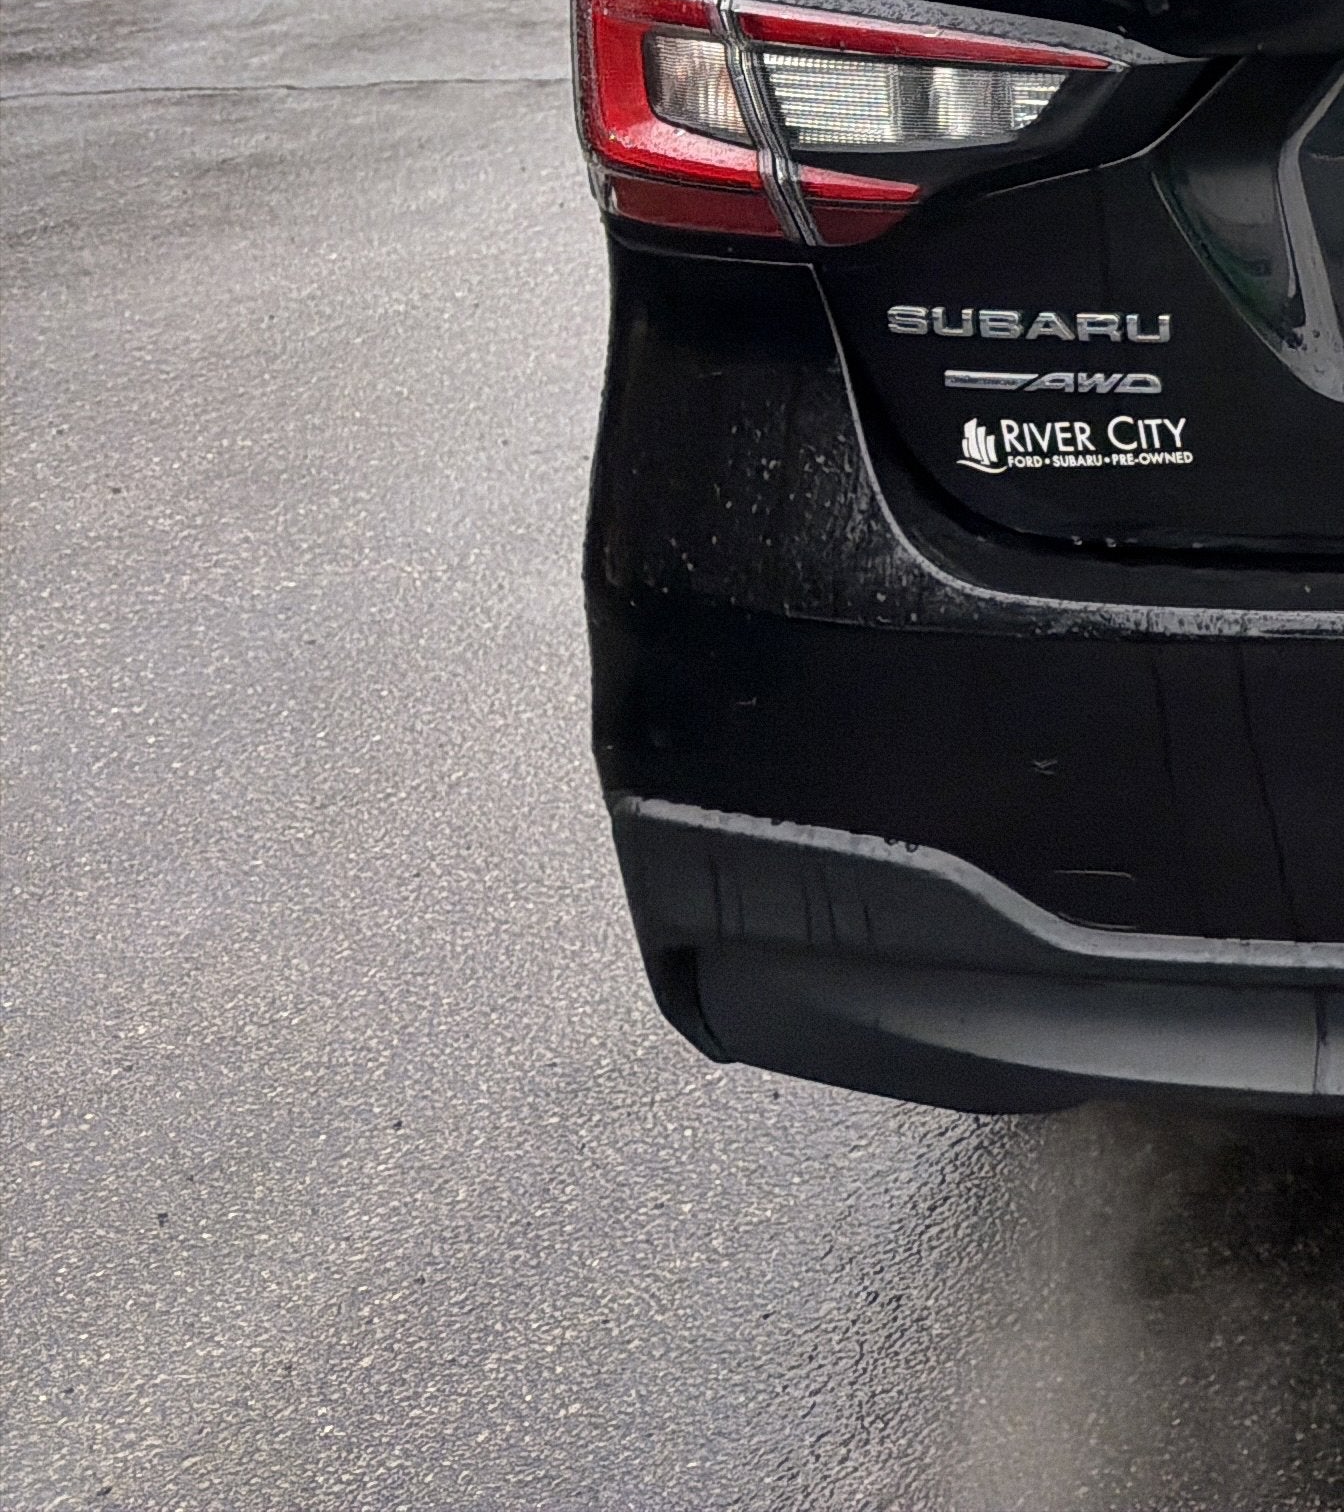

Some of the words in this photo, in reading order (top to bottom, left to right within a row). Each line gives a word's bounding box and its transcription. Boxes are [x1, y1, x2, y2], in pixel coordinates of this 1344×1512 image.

[886, 304, 1172, 344] SUBARU
[1023, 372, 1163, 394] AWD
[999, 418, 1096, 454] RIVER
[1107, 415, 1187, 451] CITY
[1007, 455, 1044, 469] FORD
[1052, 454, 1104, 468] SUBARU
[1112, 451, 1194, 466] PRE-OWNED
